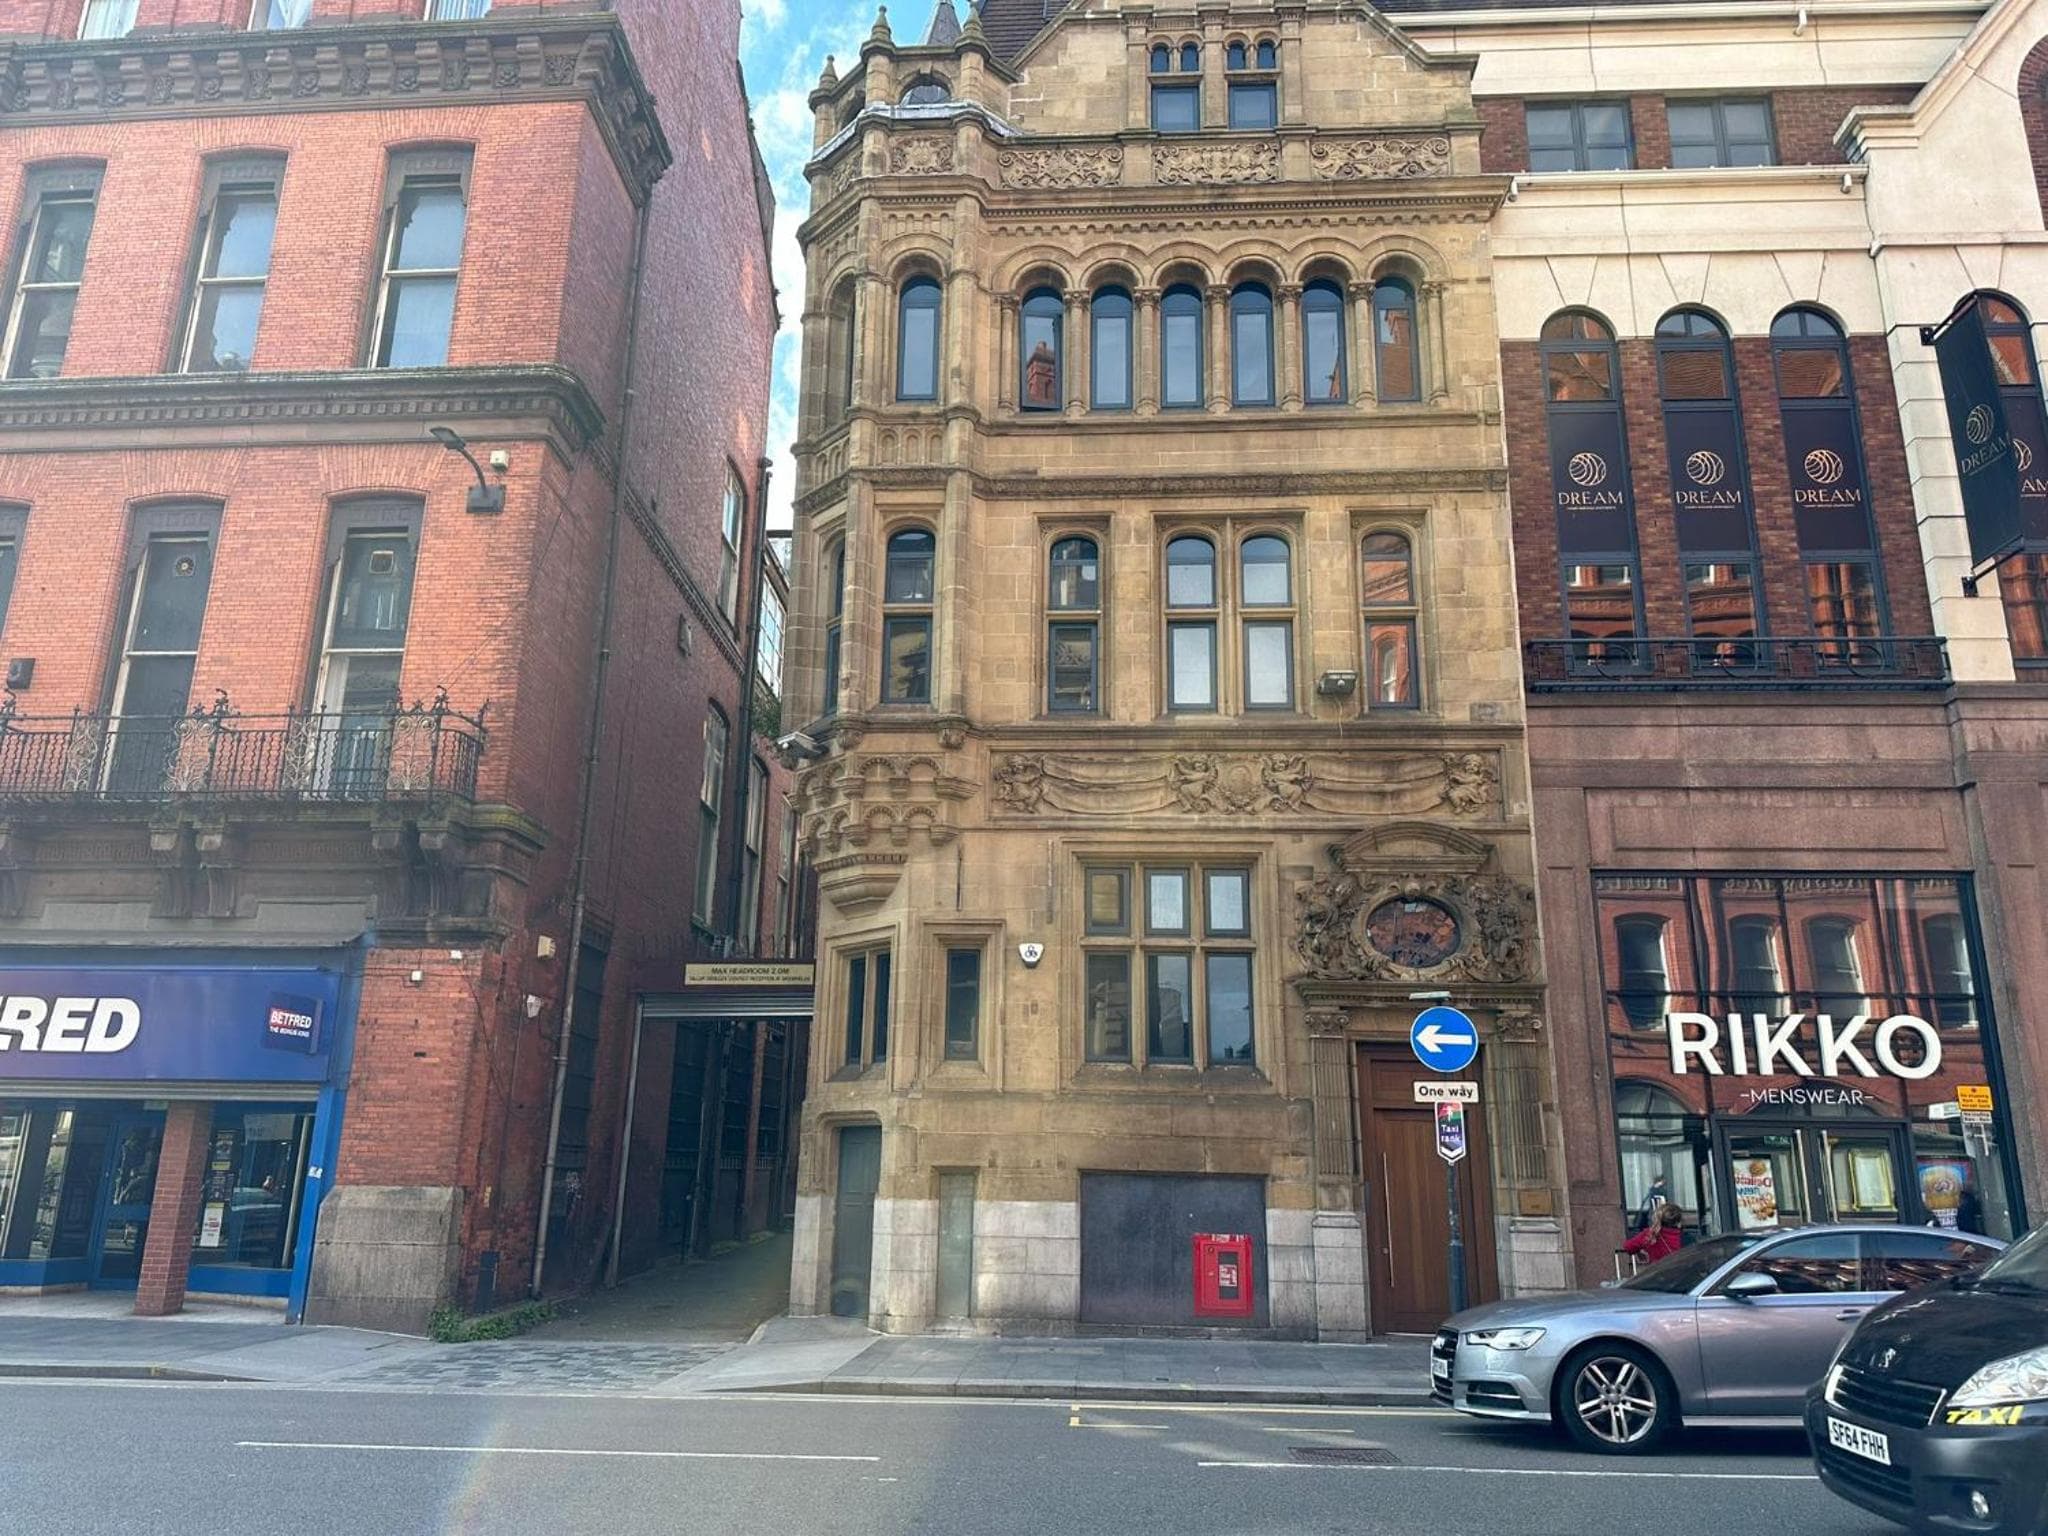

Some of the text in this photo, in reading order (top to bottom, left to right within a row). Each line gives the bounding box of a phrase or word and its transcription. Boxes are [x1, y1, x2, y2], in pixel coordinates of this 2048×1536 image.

[1961, 433, 2009, 473] DREAM
[1558, 491, 1623, 505] DREAM
[1676, 490, 1742, 504] DREAM
[1795, 488, 1862, 503] DREAM
[0, 997, 140, 1052] RED
[271, 1010, 312, 1029] BETFRED
[1667, 1012, 1942, 1080] RIKKO
[1419, 1086, 1473, 1098] One way
[1441, 1124, 1459, 1133] Taxi
[1441, 1134, 1462, 1142] rank
[1946, 1405, 2025, 1425] TAXI
[1832, 1421, 1886, 1459] SF64 FHH
